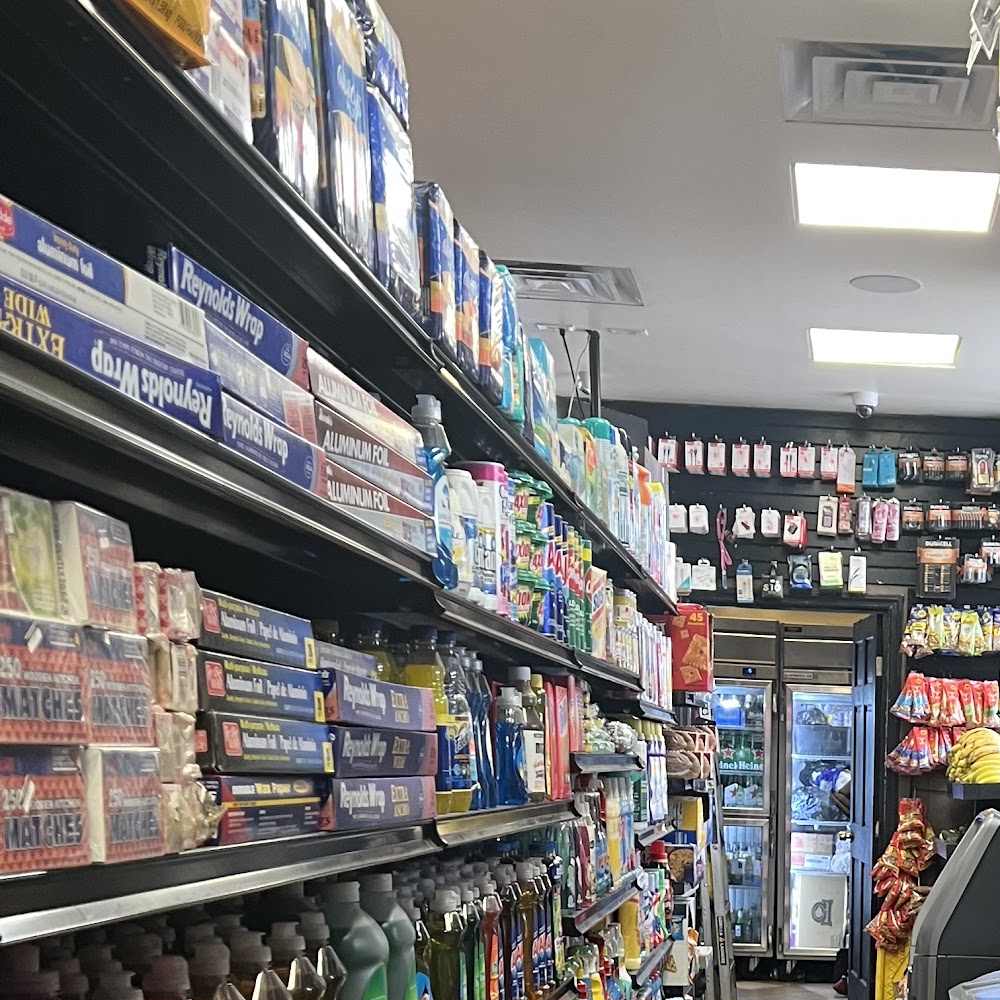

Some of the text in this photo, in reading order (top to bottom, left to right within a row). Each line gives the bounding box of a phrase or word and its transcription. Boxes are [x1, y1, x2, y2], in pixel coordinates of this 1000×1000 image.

[4, 287, 51, 328] WIDE
[181, 258, 236, 320] Reynolds
[235, 300, 264, 346] Wrap
[91, 339, 213, 429] Reynolds Wrap
[318, 374, 362, 409] ALUMINUM
[263, 420, 288, 466] Wrap
[323, 429, 390, 467] ALUMINUM FOIL
[327, 479, 390, 512] ALUMINUM FOIL
[689, 612, 704, 622] 45
